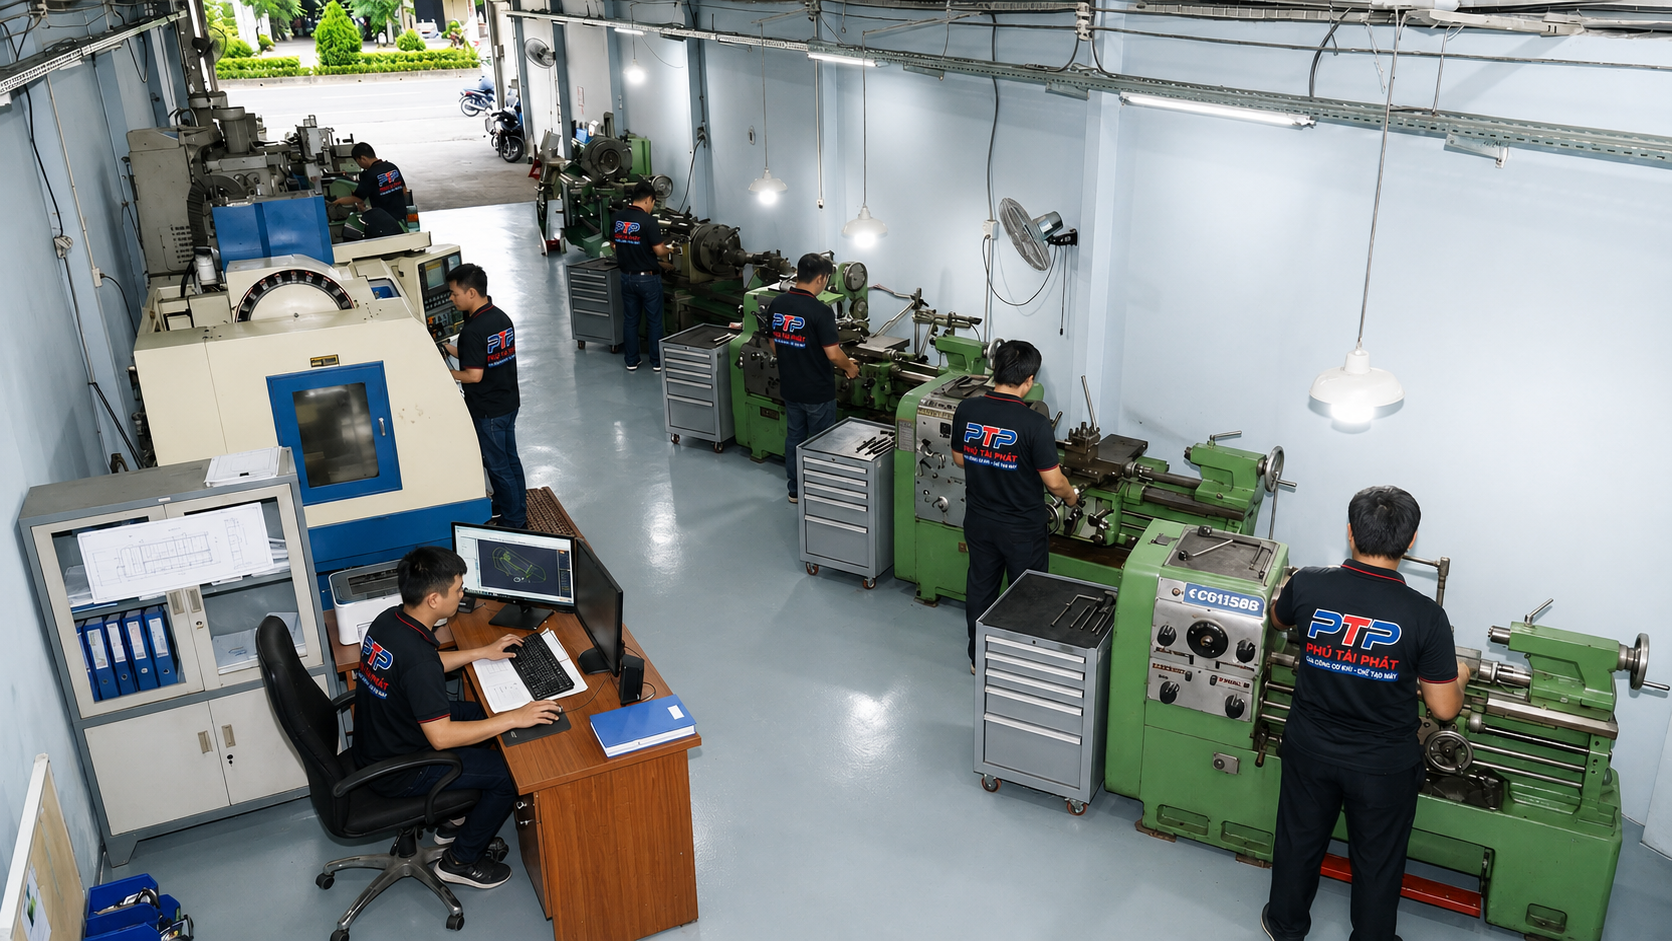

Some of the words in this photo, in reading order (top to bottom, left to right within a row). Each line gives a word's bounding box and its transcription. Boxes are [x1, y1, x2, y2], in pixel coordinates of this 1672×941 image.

[614, 220, 641, 234] PTP
[772, 312, 806, 332] PTP
[963, 421, 1018, 449] PTP
[1307, 608, 1402, 650] PTP
[361, 635, 394, 671] PTP
[1360, 655, 1400, 671] PHÁT
